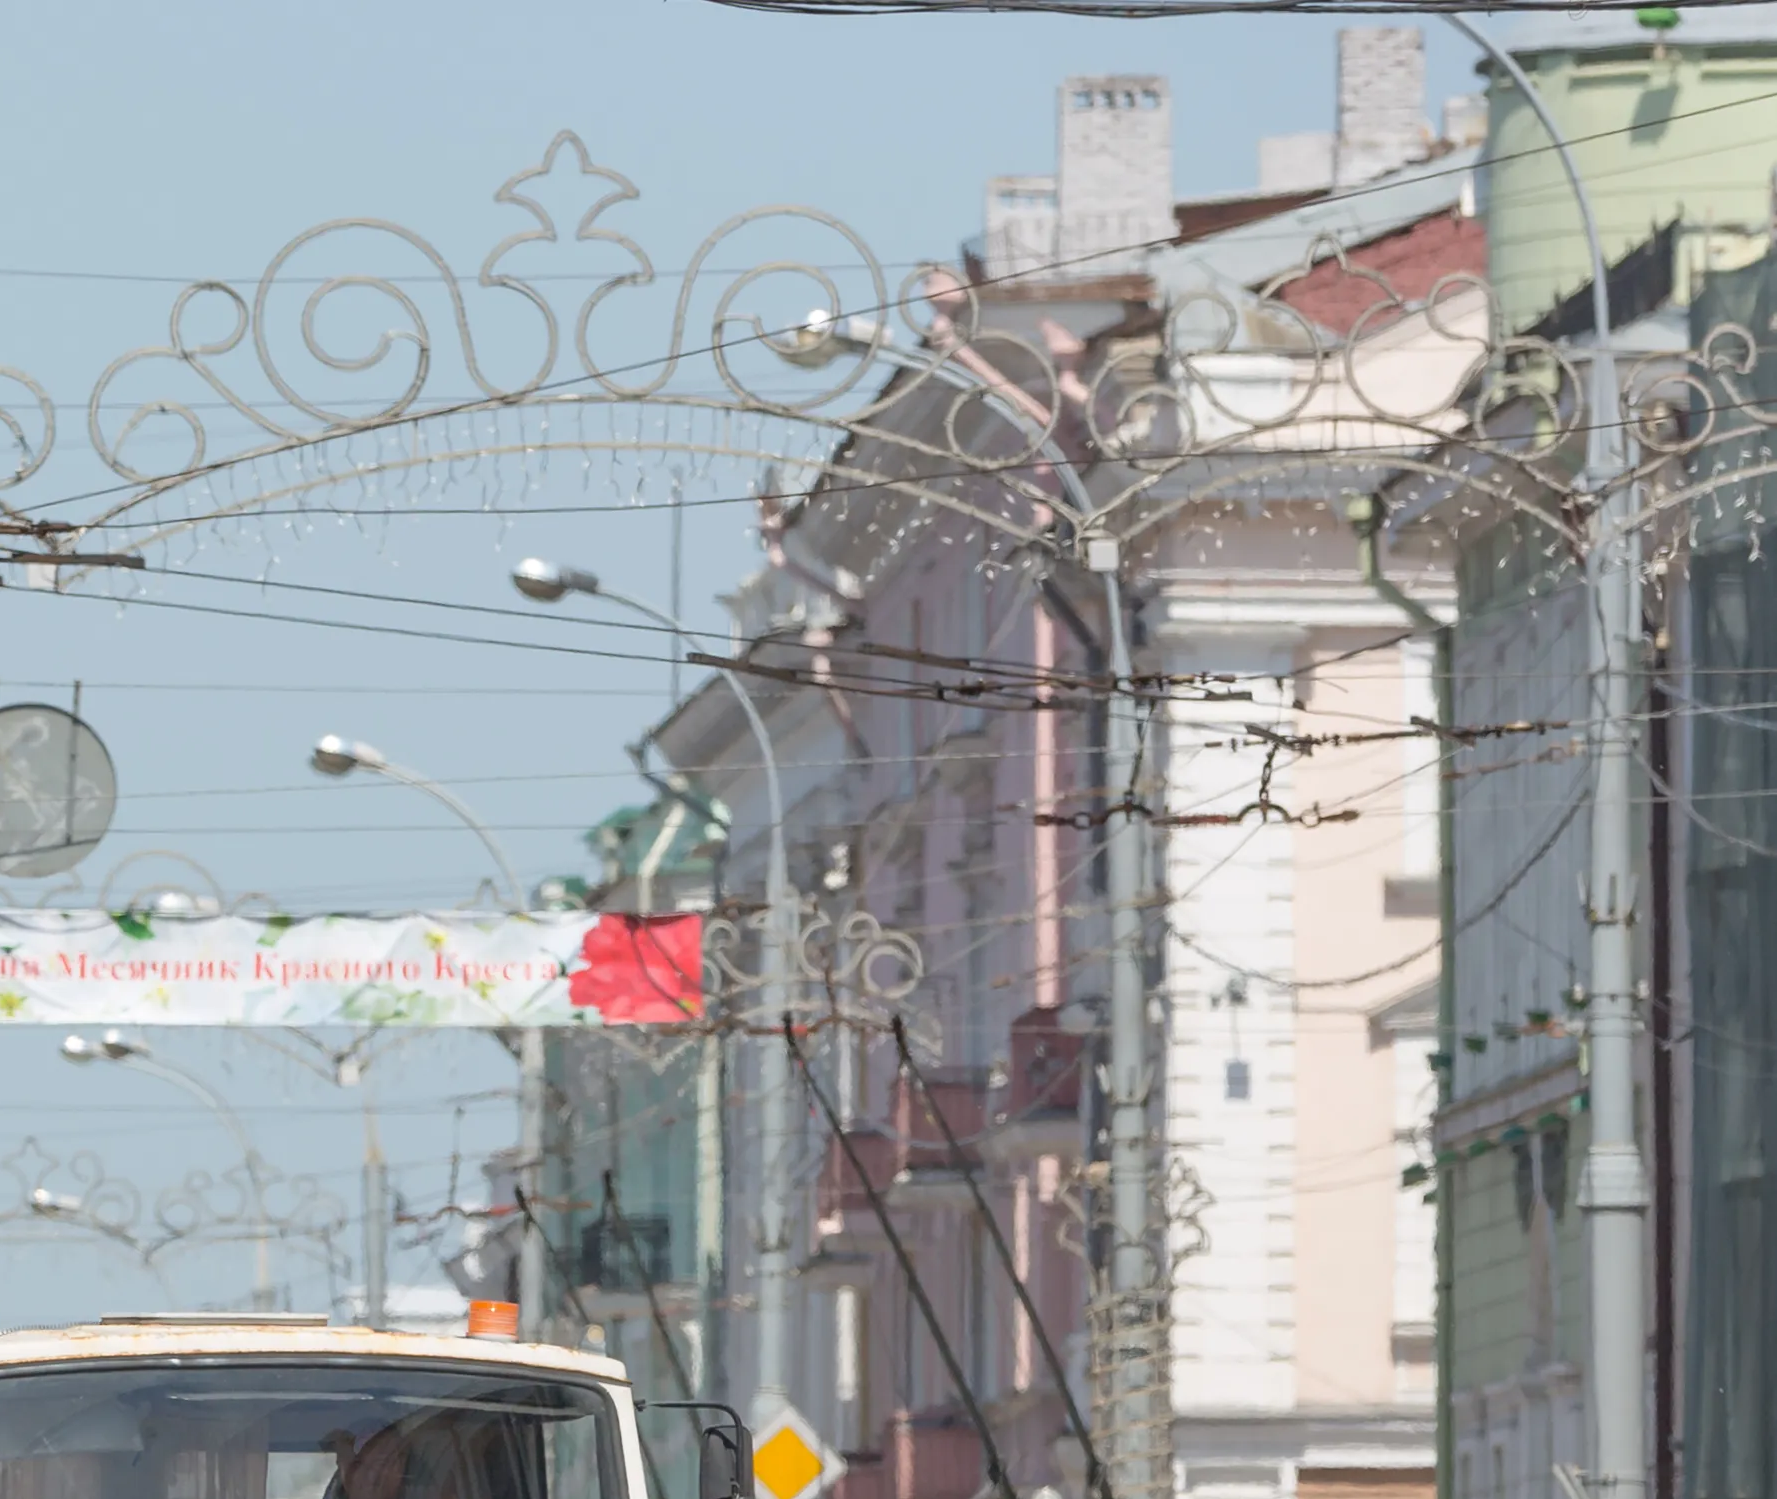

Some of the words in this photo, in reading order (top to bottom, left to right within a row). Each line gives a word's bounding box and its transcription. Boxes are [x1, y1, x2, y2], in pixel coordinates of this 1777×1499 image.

[56, 951, 241, 982] Месячник
[254, 951, 422, 987] Красного
[433, 951, 557, 987] Креста
